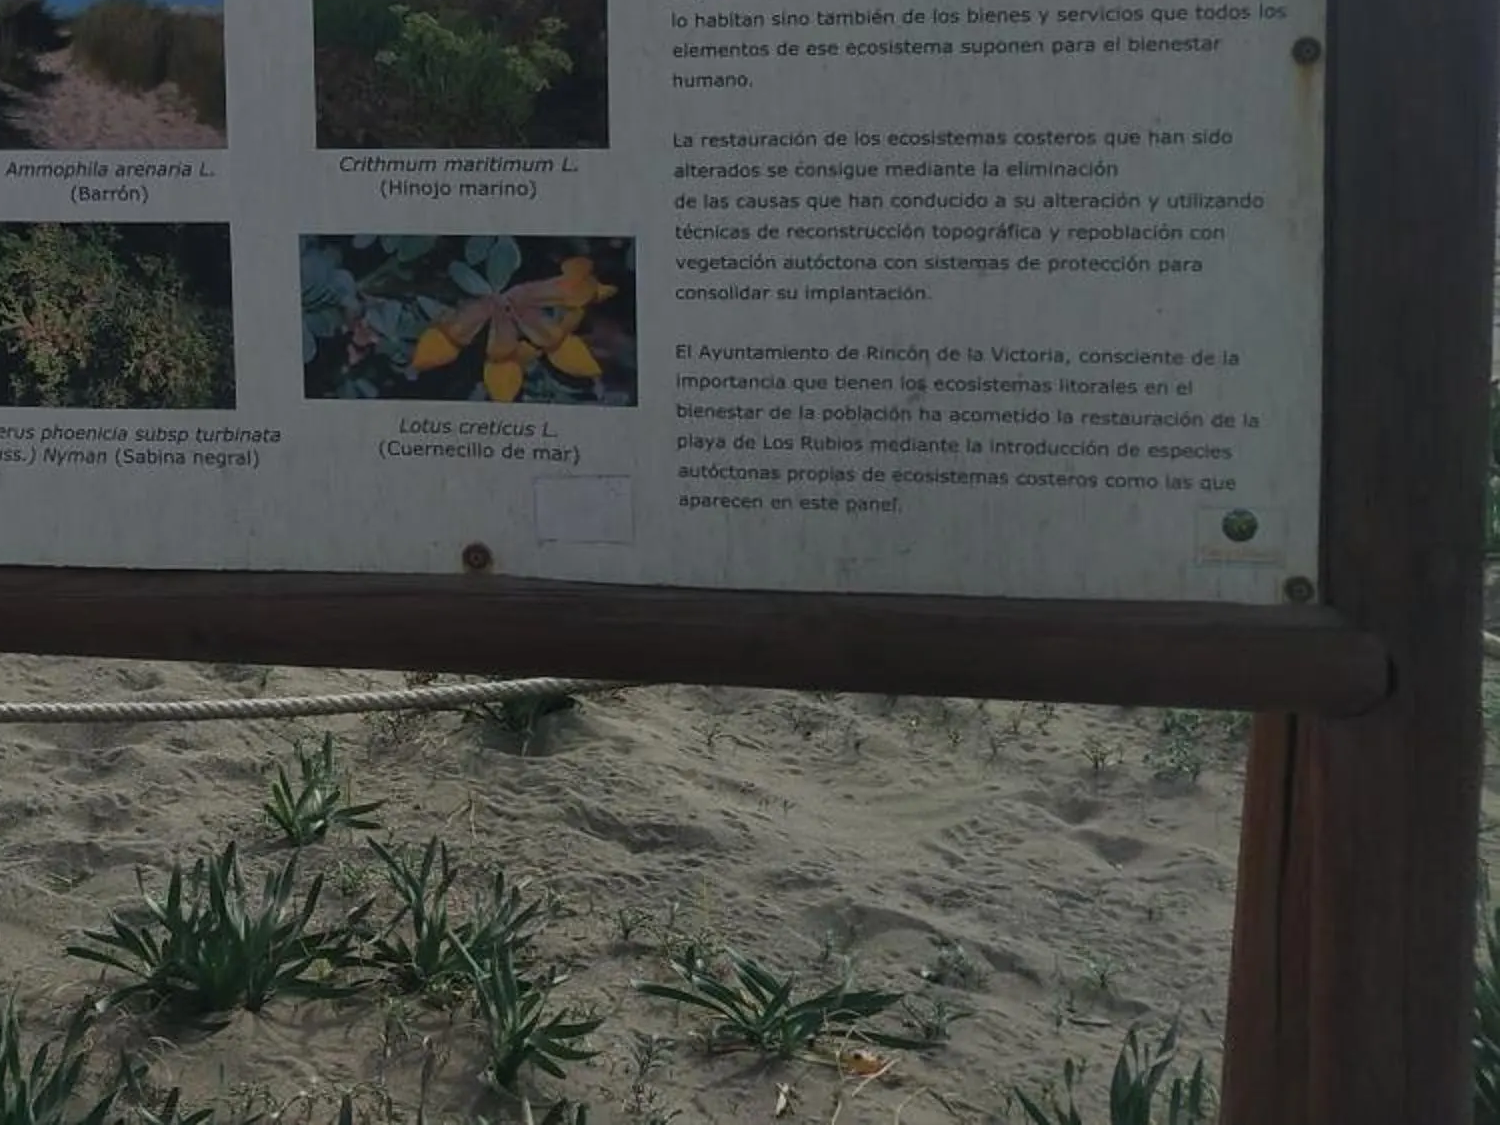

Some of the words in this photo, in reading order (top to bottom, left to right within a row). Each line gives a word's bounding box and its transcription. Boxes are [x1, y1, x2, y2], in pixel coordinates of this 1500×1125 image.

[671, 11, 689, 29] lo
[694, 11, 765, 29] habitan
[771, 10, 811, 27] sino
[816, 8, 895, 26] también
[901, 8, 926, 25] de
[932, 7, 961, 25] los
[966, 7, 1032, 24] bienes
[1037, 10, 1050, 26] y
[1056, 6, 1145, 23] servicios
[1150, 7, 1189, 25] que
[1194, 3, 1252, 21] todos
[1258, 1, 1288, 20] los
[672, 132, 694, 149] La
[700, 131, 818, 148] restauración
[823, 131, 848, 147] de
[854, 130, 882, 147] los
[886, 130, 1008, 147] ecosistemas
[1013, 130, 1097, 147] costeros
[1103, 131, 1142, 149] que
[1147, 129, 1186, 147] han
[1191, 128, 1233, 145] sido
[5, 160, 109, 181] Ammophila
[114, 163, 193, 178] arenaria
[339, 156, 437, 173] Crithmum
[443, 156, 554, 173] maritimum
[70, 183, 149, 205] (Barrón)
[379, 178, 453, 200] (Hinojo
[458, 179, 537, 200] marino)
[673, 193, 698, 210] de
[703, 193, 730, 210] las
[735, 195, 801, 210] causas
[805, 195, 842, 212] que
[848, 192, 884, 210] han
[889, 191, 989, 209] conducido
[994, 194, 1007, 209] a
[1012, 195, 1036, 209] su
[1042, 191, 1141, 209] alteración
[1147, 195, 1160, 213] y
[1166, 191, 1265, 210] utilizando
[675, 222, 752, 241] técnicas
[756, 223, 780, 240] de
[786, 222, 926, 240] reconstrucción
[931, 222, 1042, 244] topográfica
[1048, 226, 1061, 244] y
[1067, 222, 1184, 243] repoblación
[1188, 227, 1226, 241] con
[675, 343, 693, 360] El
[698, 344, 830, 362] Ayuntamiento
[835, 345, 860, 361] de
[866, 344, 931, 364] Rincón
[936, 346, 962, 362] de
[966, 346, 984, 363] la
[990, 346, 1071, 366] Victoria,
[1078, 349, 1185, 366] consciente
[1190, 349, 1216, 367] de
[1221, 350, 1240, 367] la
[134, 426, 190, 446] subsp
[195, 426, 282, 444] turbinata
[399, 417, 453, 435] Lotus
[458, 420, 537, 438] creticus
[378, 439, 495, 460] (Cuernecillo
[501, 442, 526, 460] de
[531, 445, 581, 467] mar)
[676, 432, 727, 453] playa
[732, 433, 757, 451] de
[762, 434, 795, 451] Los
[799, 434, 864, 452] Rubios
[868, 435, 960, 454] mediante
[965, 437, 984, 454] la
[989, 438, 1110, 458] introducción
[1116, 441, 1141, 459] de
[1147, 443, 1233, 461] especies
[42, 446, 108, 467] Nyman
[114, 447, 186, 468] (Sabina
[192, 448, 260, 470] negral)
